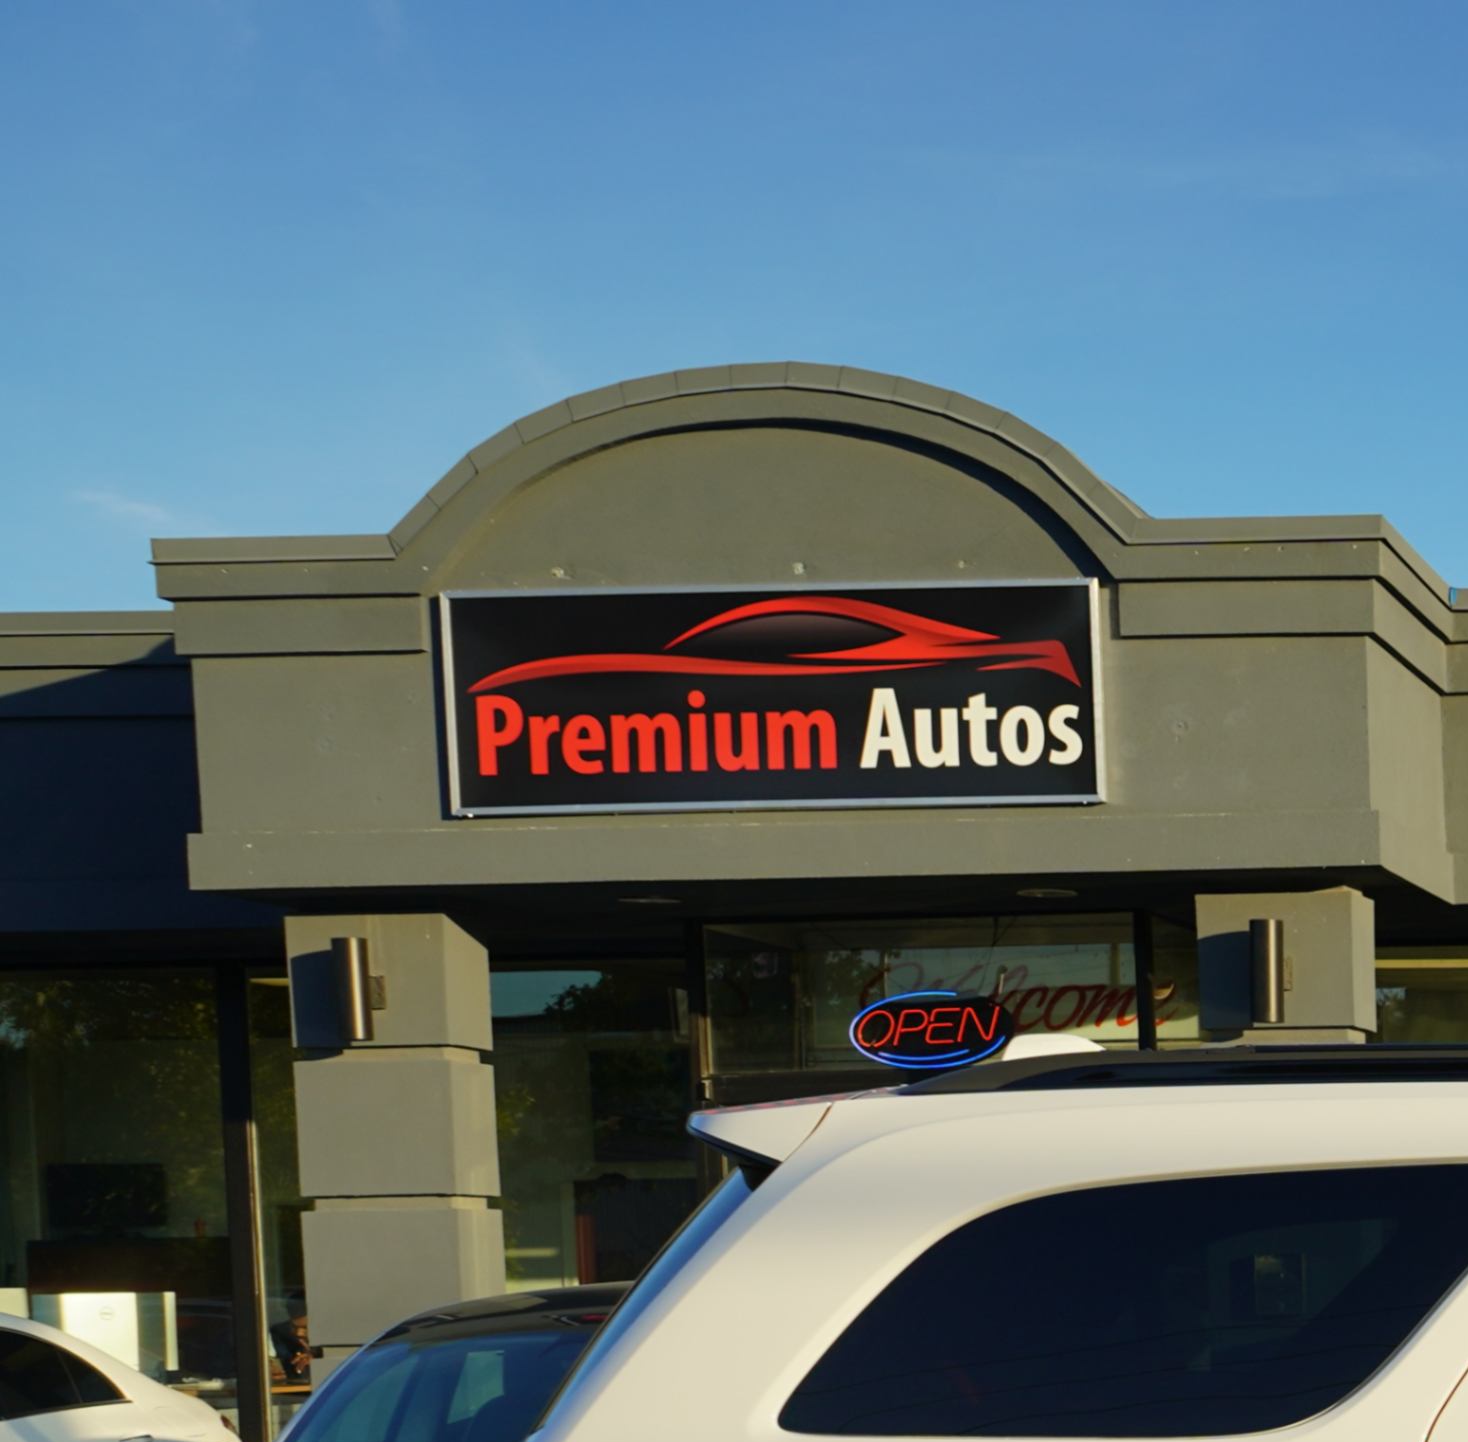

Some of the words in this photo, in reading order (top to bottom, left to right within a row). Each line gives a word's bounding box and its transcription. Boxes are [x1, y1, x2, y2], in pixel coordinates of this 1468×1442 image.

[475, 690, 838, 776] Premium
[860, 688, 1083, 768] Autos
[857, 1006, 1000, 1048] OPEN
